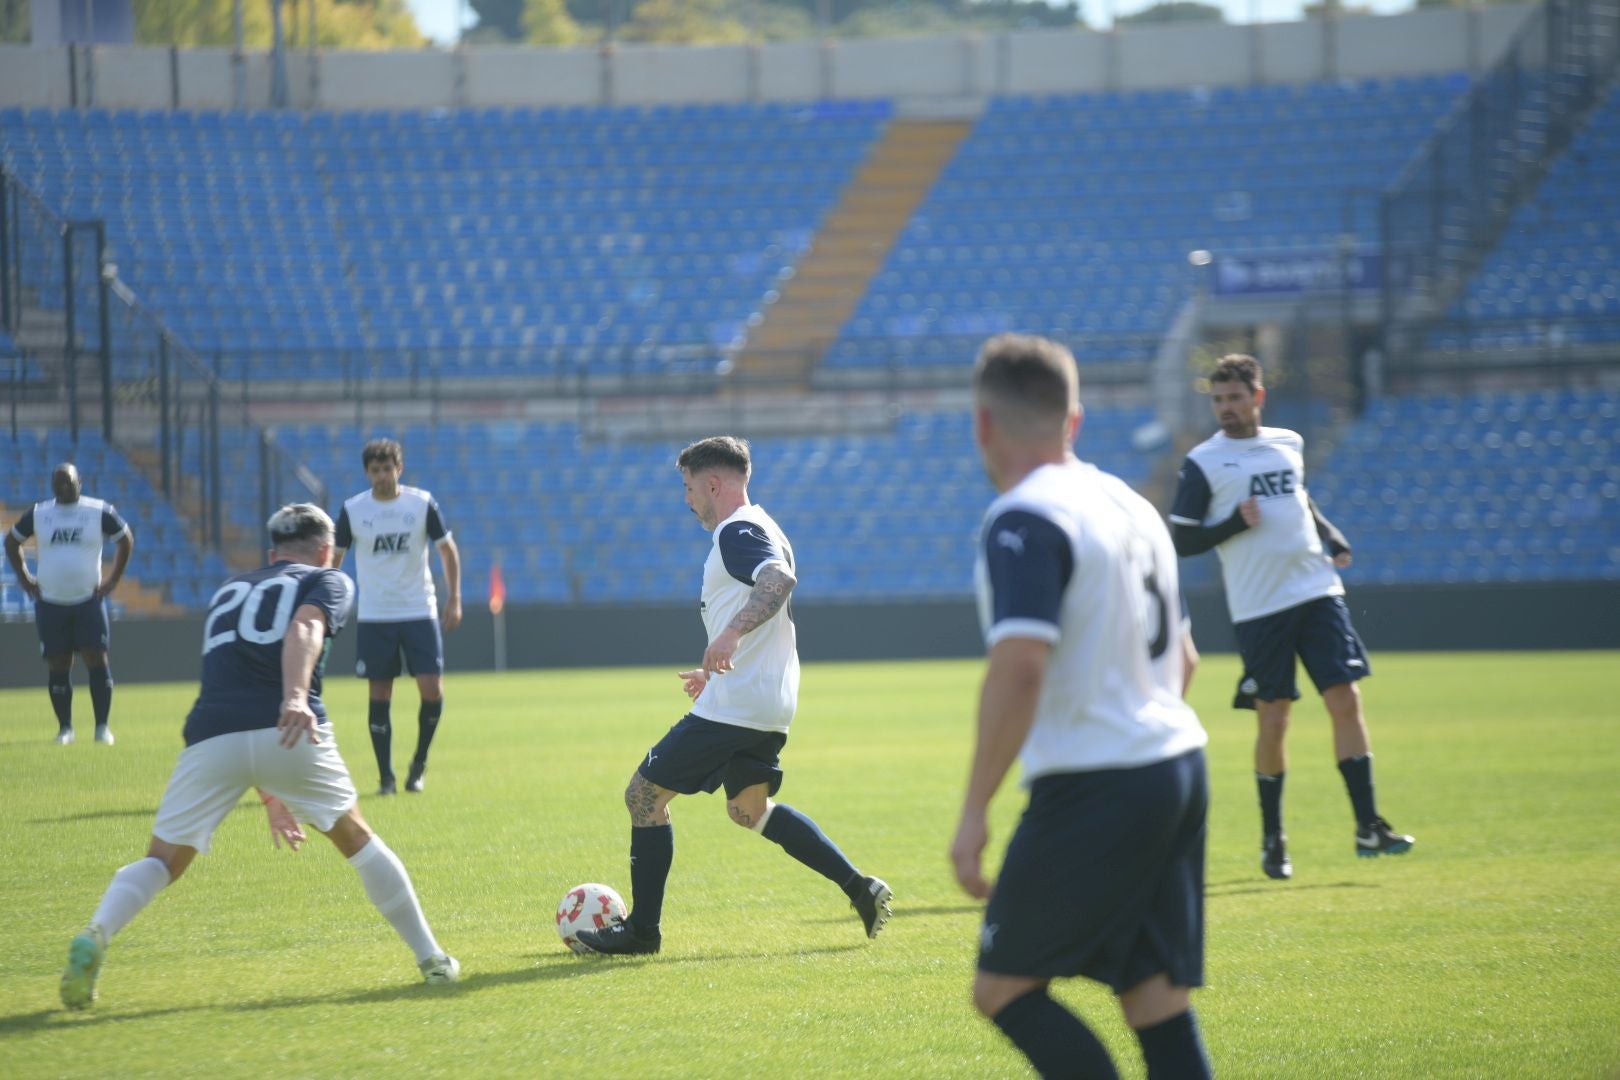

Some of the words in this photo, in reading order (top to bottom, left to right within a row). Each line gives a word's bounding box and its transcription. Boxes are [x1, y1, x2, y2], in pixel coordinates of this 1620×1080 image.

[1249, 470, 1294, 497] AFE
[373, 532, 411, 554] AFE
[202, 576, 298, 655] 20
